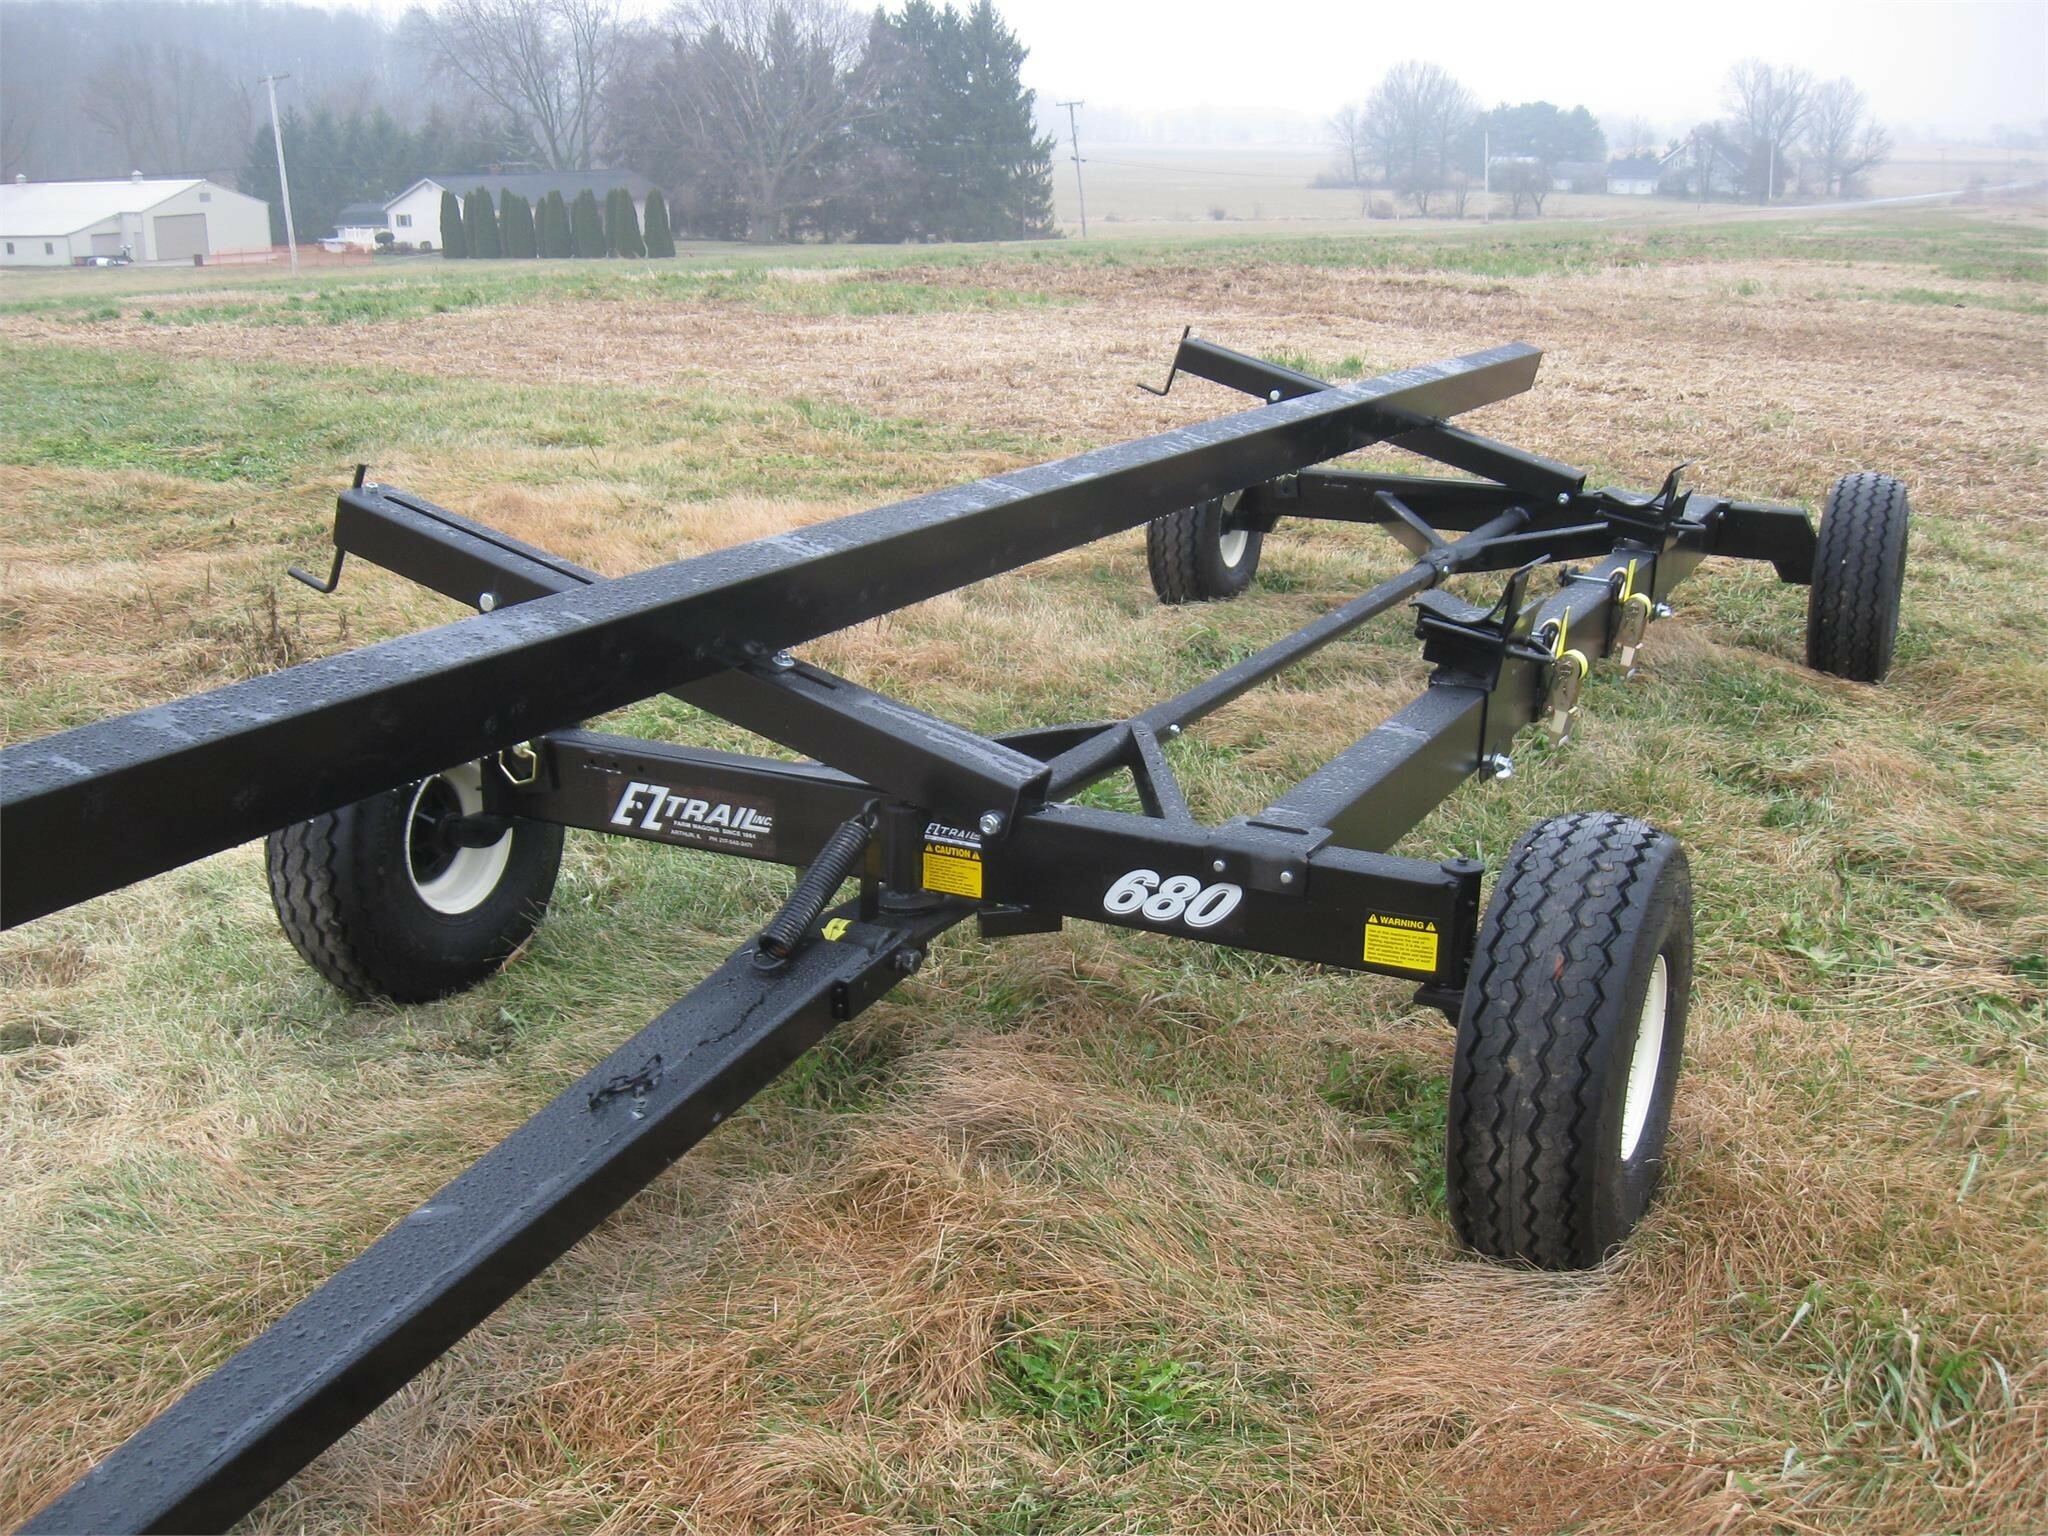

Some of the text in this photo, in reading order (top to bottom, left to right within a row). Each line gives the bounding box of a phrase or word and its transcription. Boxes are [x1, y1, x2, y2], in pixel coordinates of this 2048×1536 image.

[934, 845, 971, 859] CAUTION
[1103, 868, 1243, 928] 680
[1380, 915, 1425, 930] WARNING
